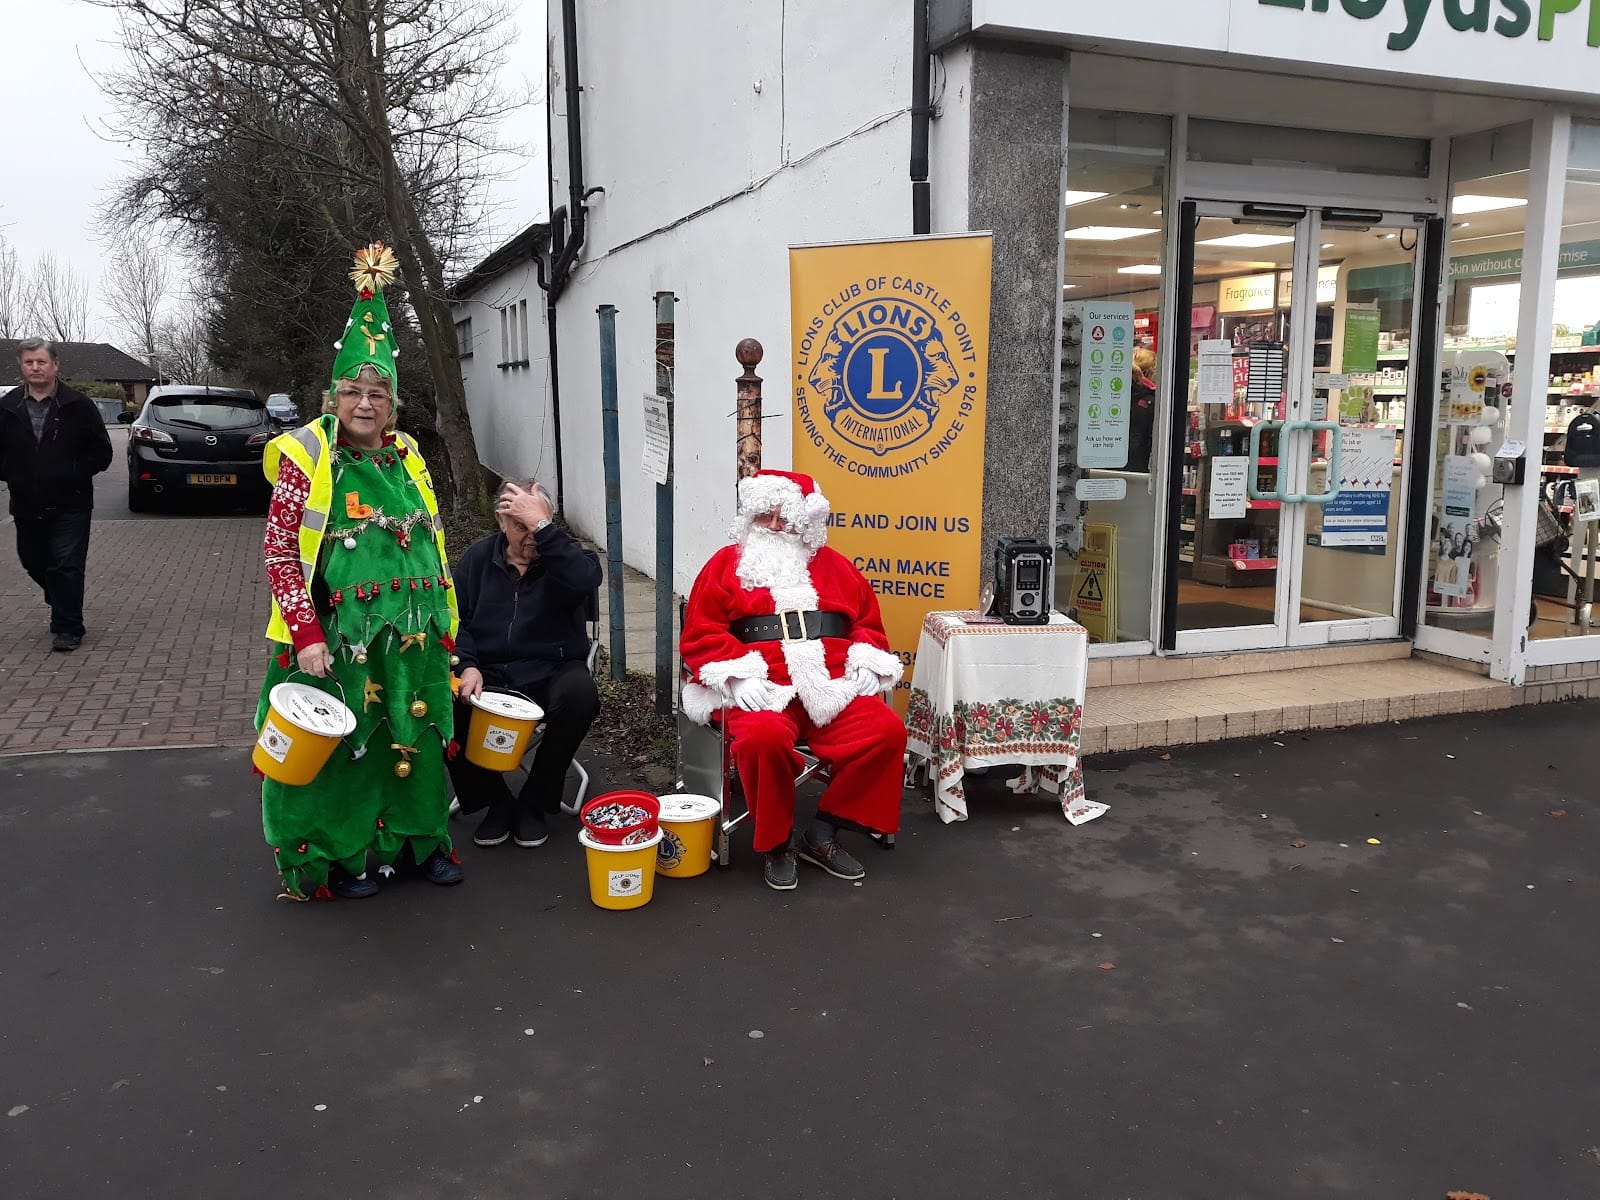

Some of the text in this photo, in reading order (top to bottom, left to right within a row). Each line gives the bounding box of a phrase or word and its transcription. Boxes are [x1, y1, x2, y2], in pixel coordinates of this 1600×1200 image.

[1448, 262, 1468, 275] Skin
[1471, 257, 1511, 273] without
[1225, 287, 1271, 302] Fragrance
[798, 276, 976, 365] LIONS CLUB OF CASTLE POINT
[842, 304, 927, 338] LIONS
[1089, 311, 1130, 321] Our services
[867, 348, 903, 400] L
[796, 385, 977, 478] SERVING THE COMMUNITY SINCE 1978
[840, 414, 923, 442] INTERNATIONAL
[214, 474, 231, 483] BFW
[825, 512, 970, 533] ME AND JOIN US
[853, 556, 950, 577] CAN MAKE
[1080, 559, 1106, 569] CAUTION
[868, 578, 945, 599] ERENCE
